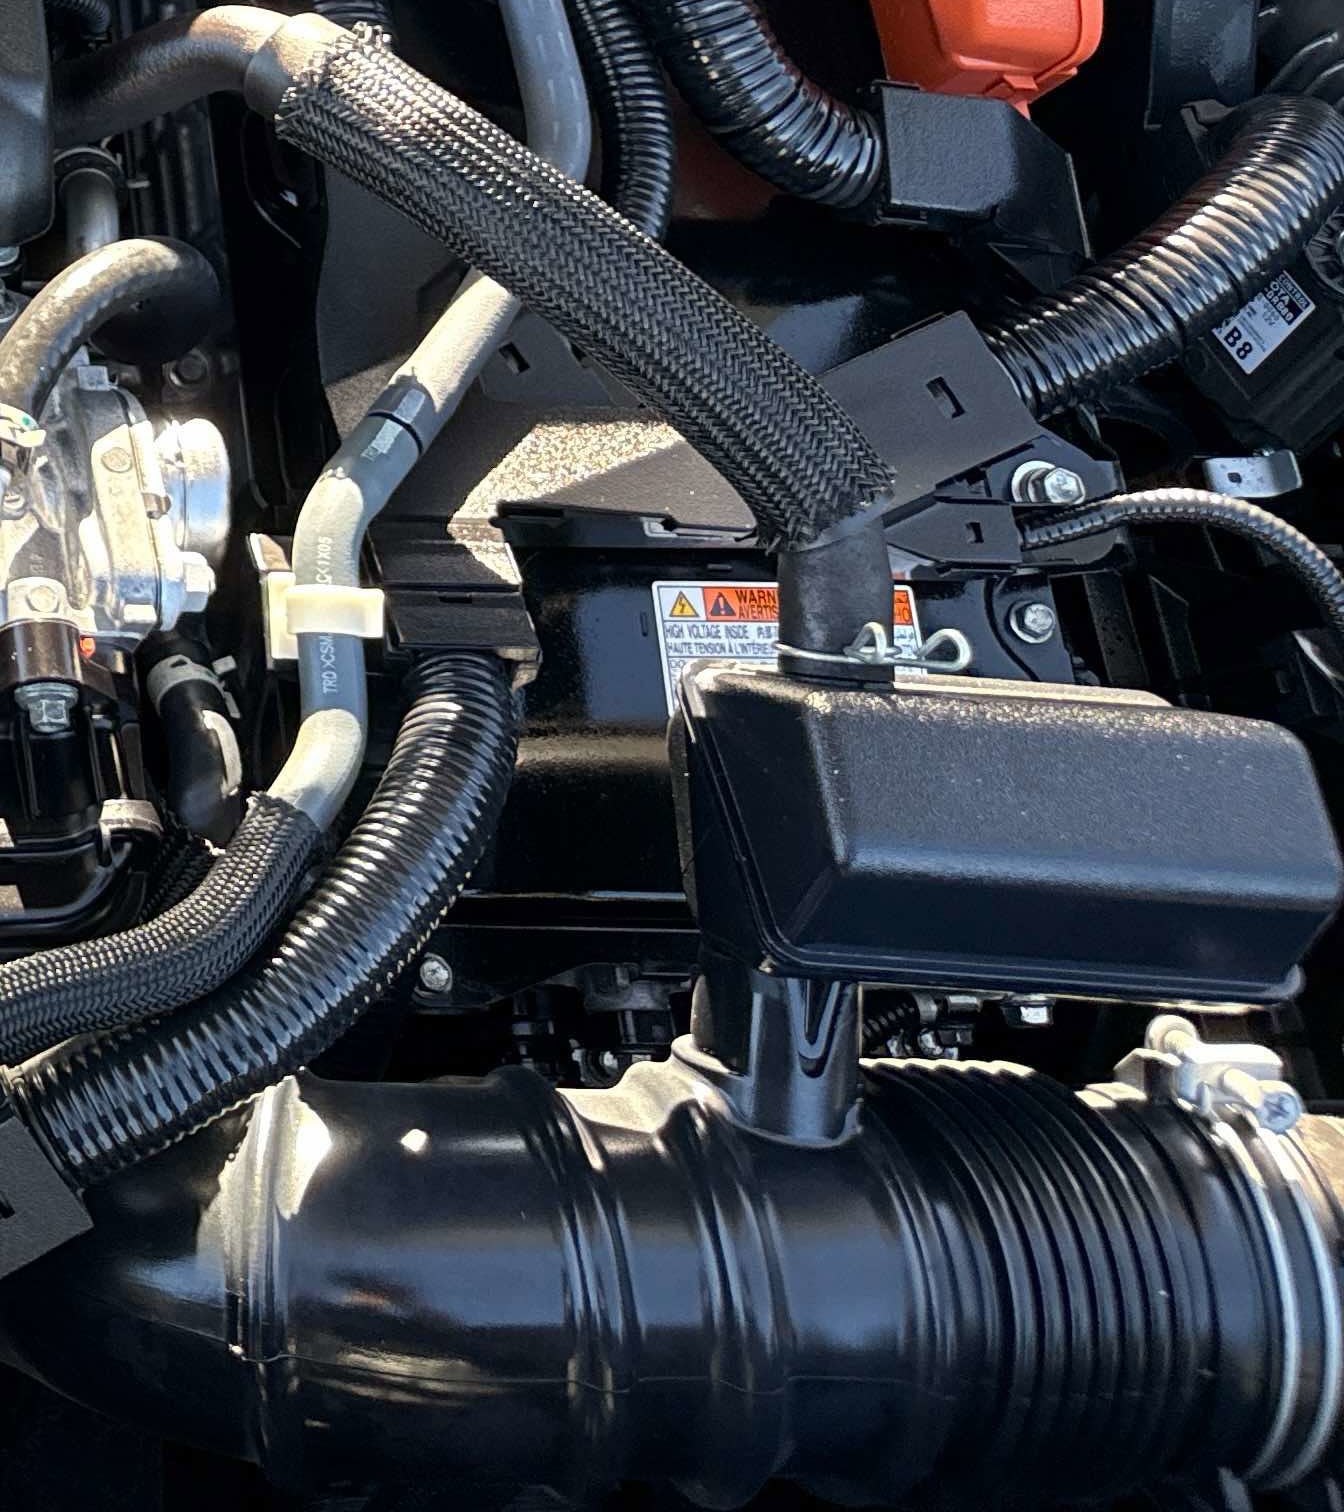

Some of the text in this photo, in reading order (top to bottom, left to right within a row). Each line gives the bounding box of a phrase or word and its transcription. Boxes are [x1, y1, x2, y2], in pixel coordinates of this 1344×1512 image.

[1269, 280, 1290, 306] OTA
[1222, 325, 1255, 361] B8
[735, 590, 778, 604] WARN
[738, 606, 779, 619] AVERTIS
[665, 625, 684, 638] HIGH
[687, 625, 721, 639] VOLTAGE
[725, 625, 749, 639] INSIDE
[694, 641, 726, 654] TENSION
